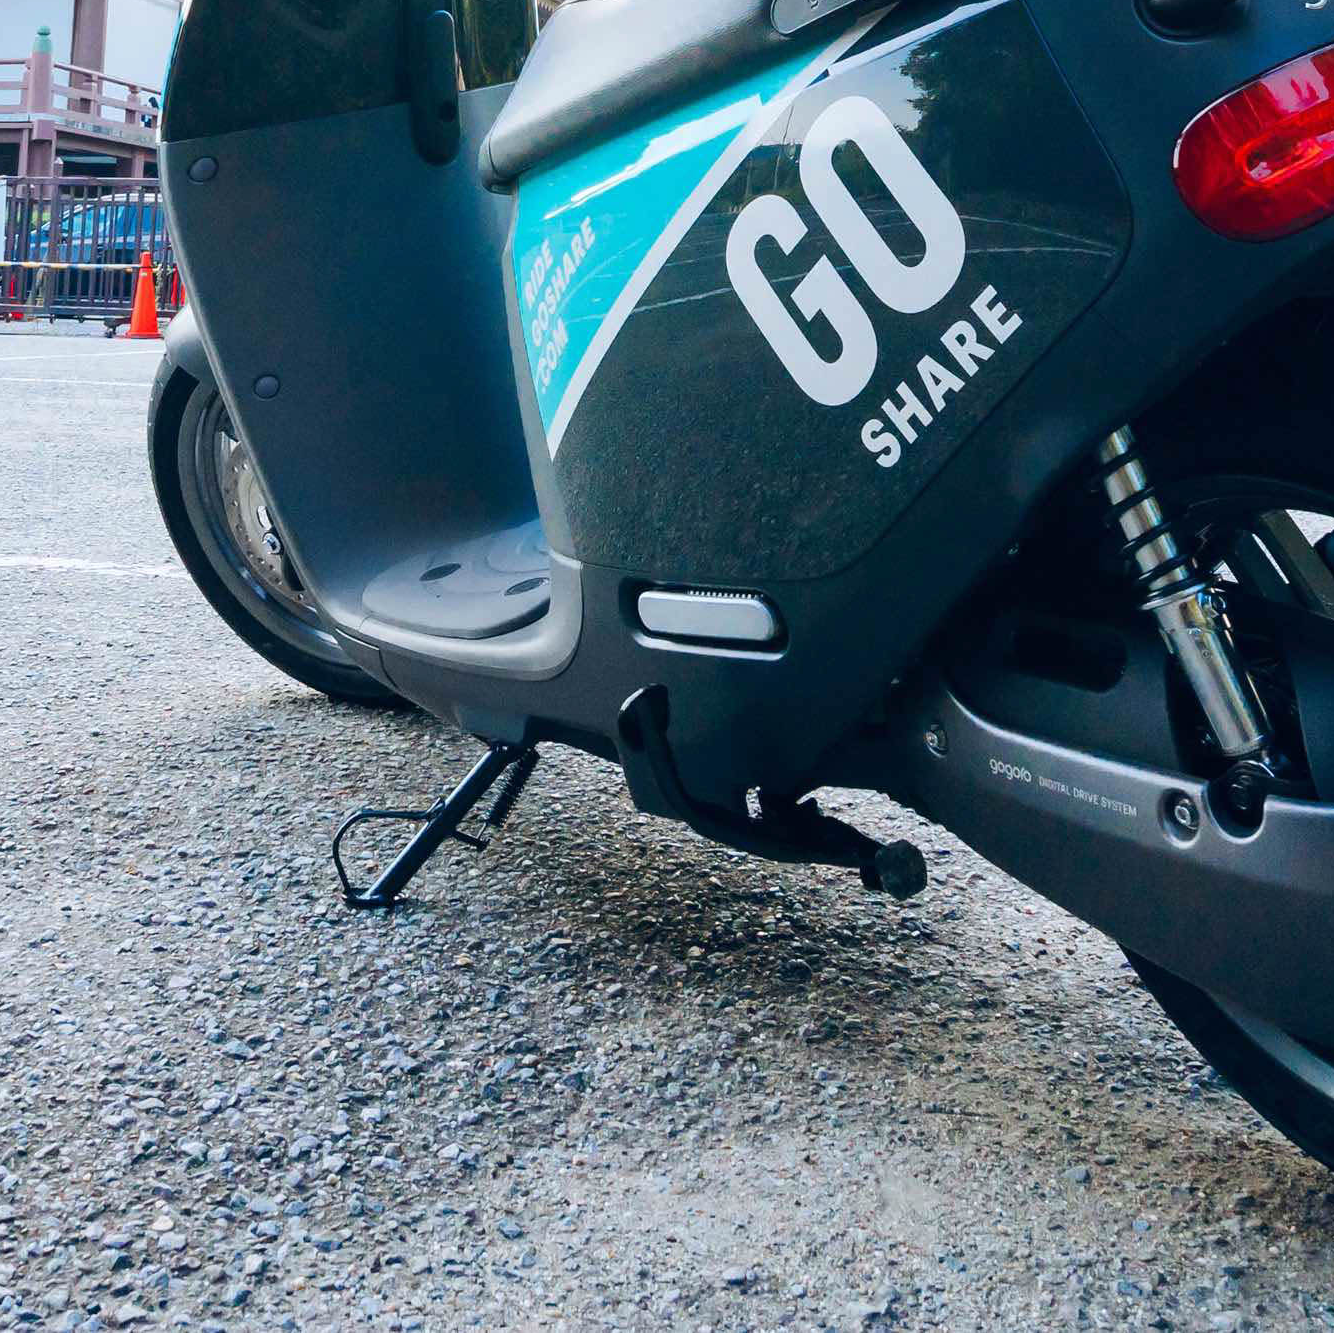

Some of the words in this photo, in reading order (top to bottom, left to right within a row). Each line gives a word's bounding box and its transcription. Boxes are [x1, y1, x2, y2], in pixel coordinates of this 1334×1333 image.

[525, 237, 554, 311] RIDE
[532, 215, 596, 347] GOSHARE
[725, 94, 966, 407] GO
[860, 284, 1025, 469] SHARE
[988, 758, 1033, 783] gogoro
[1038, 776, 1070, 796] DIGITAL
[1073, 786, 1100, 806] DRIVE
[1101, 796, 1138, 817] SYSTEM
